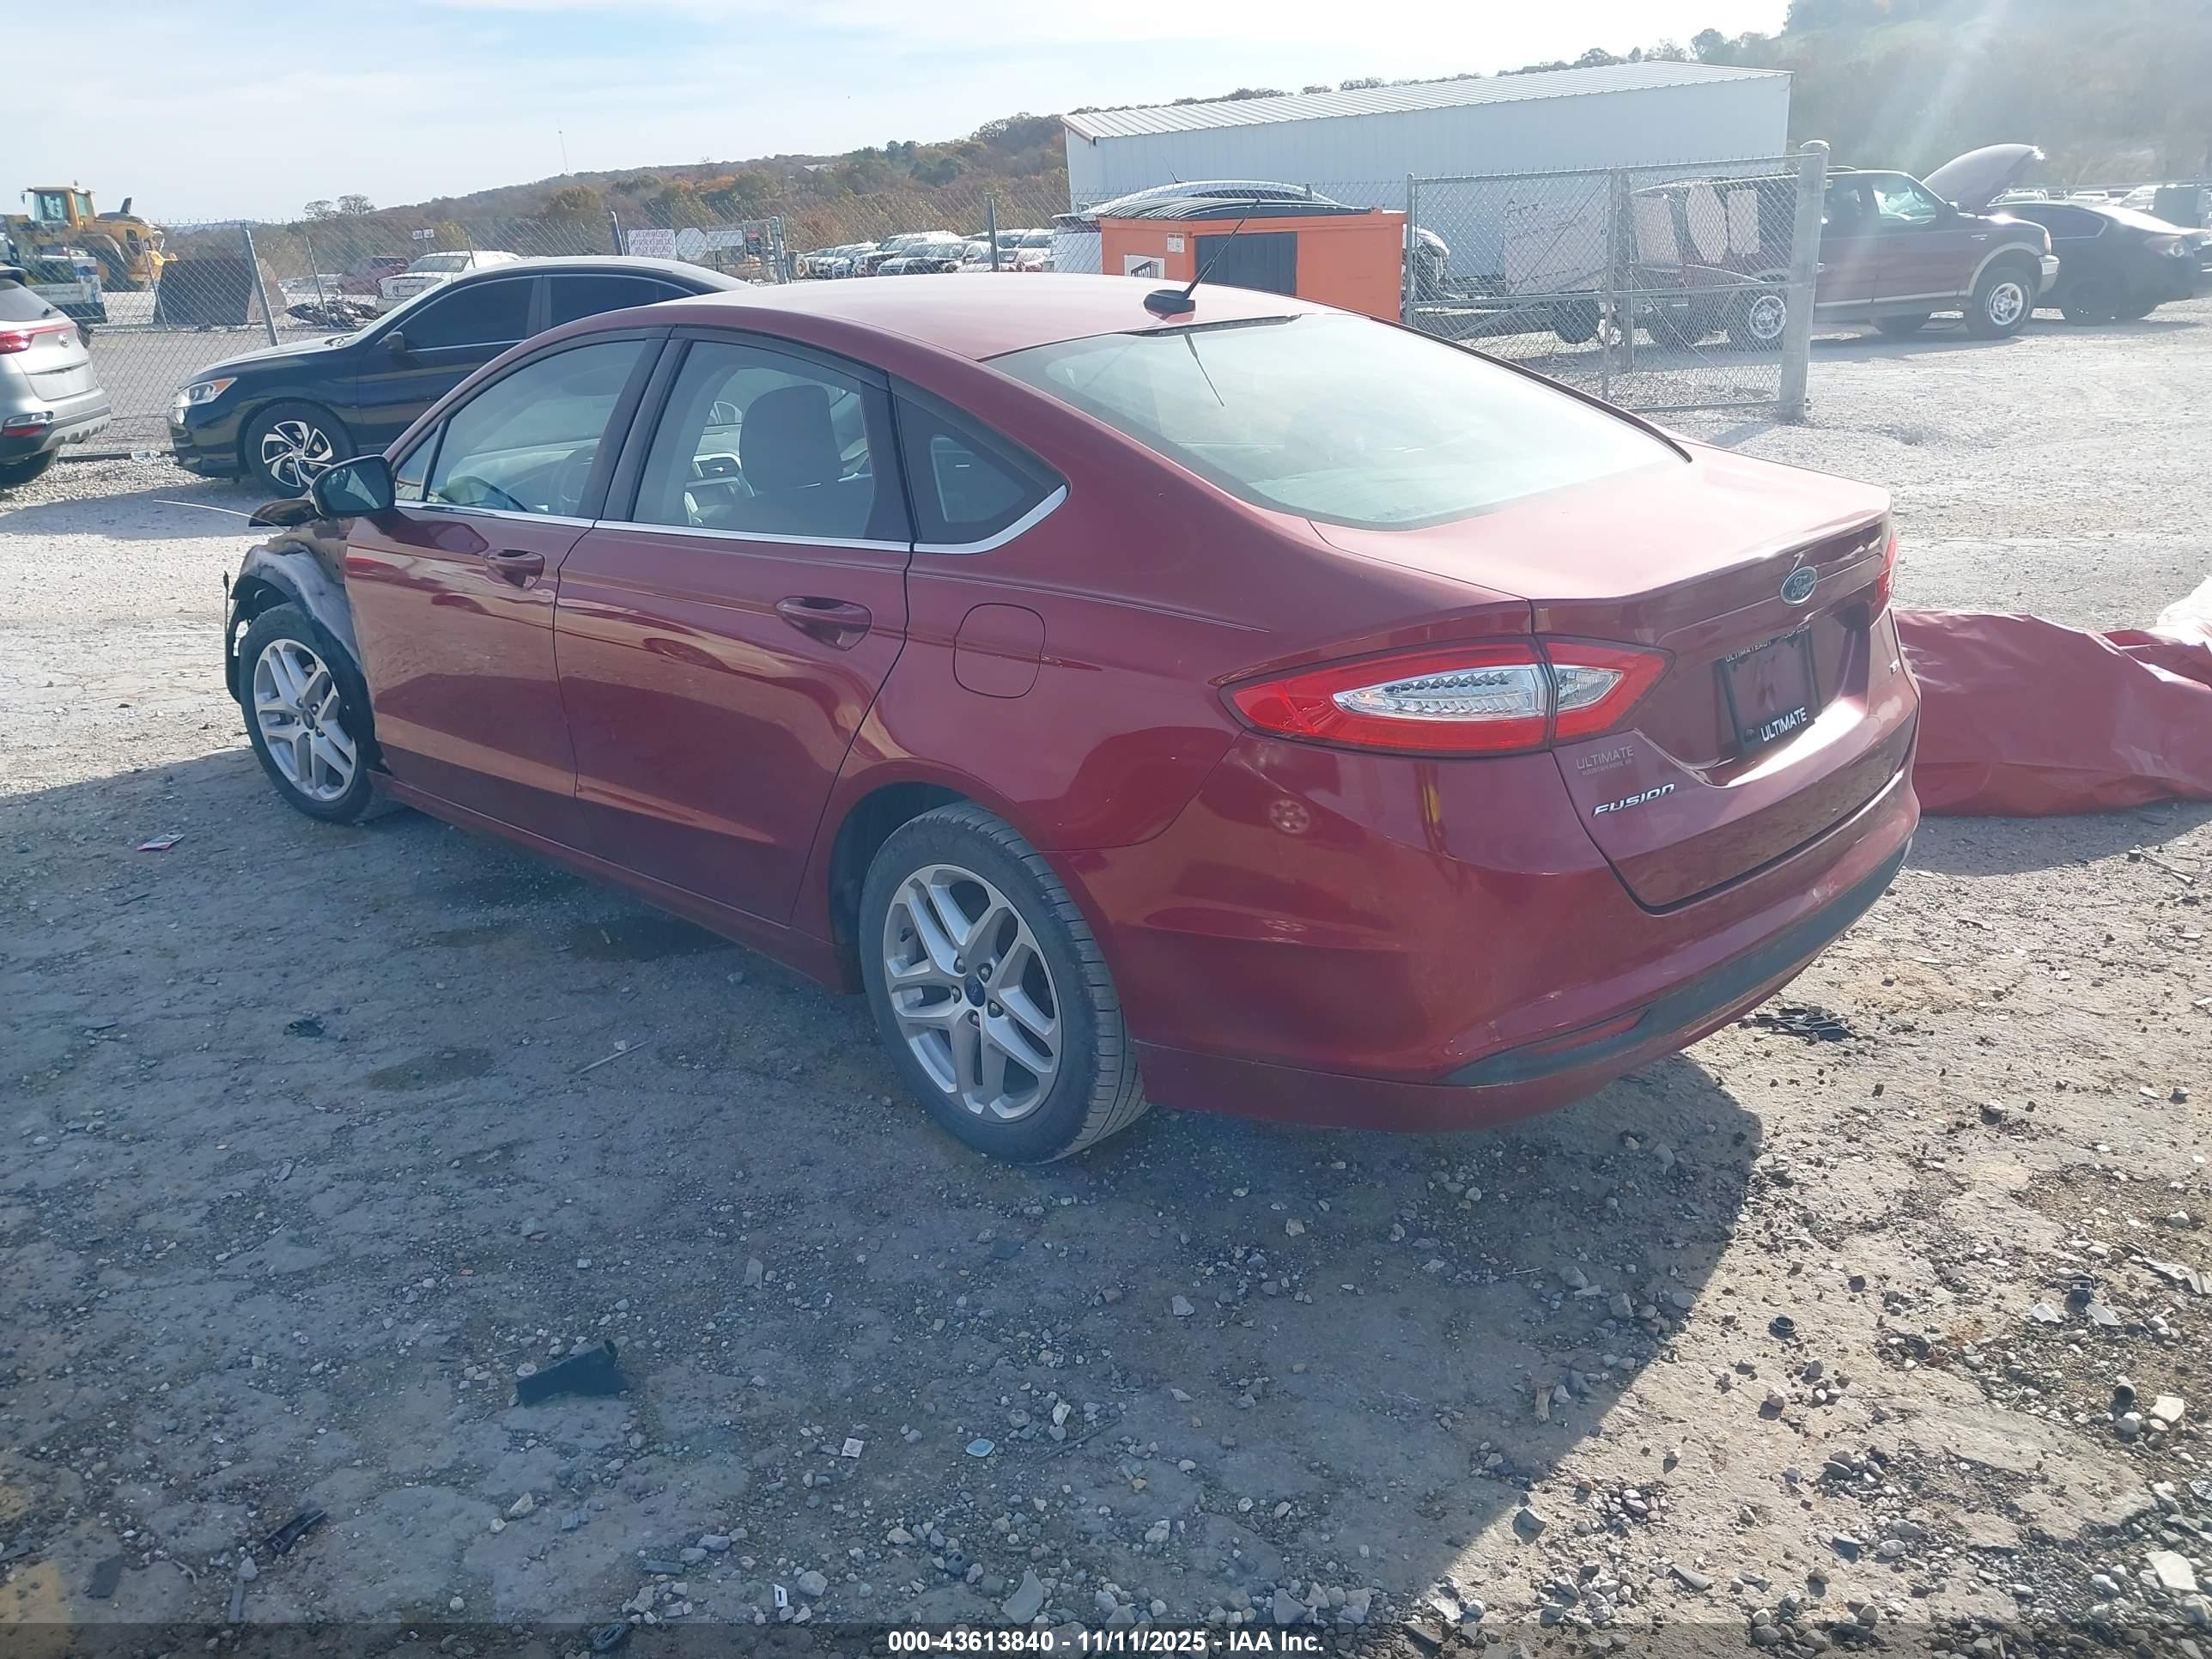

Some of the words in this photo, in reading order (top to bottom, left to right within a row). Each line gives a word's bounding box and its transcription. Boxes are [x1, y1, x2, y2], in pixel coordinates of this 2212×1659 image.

[1760, 706, 1808, 743] ULTIMATE
[1576, 744, 1635, 770] ULTIMATE
[1591, 782, 1676, 818] FUSION
